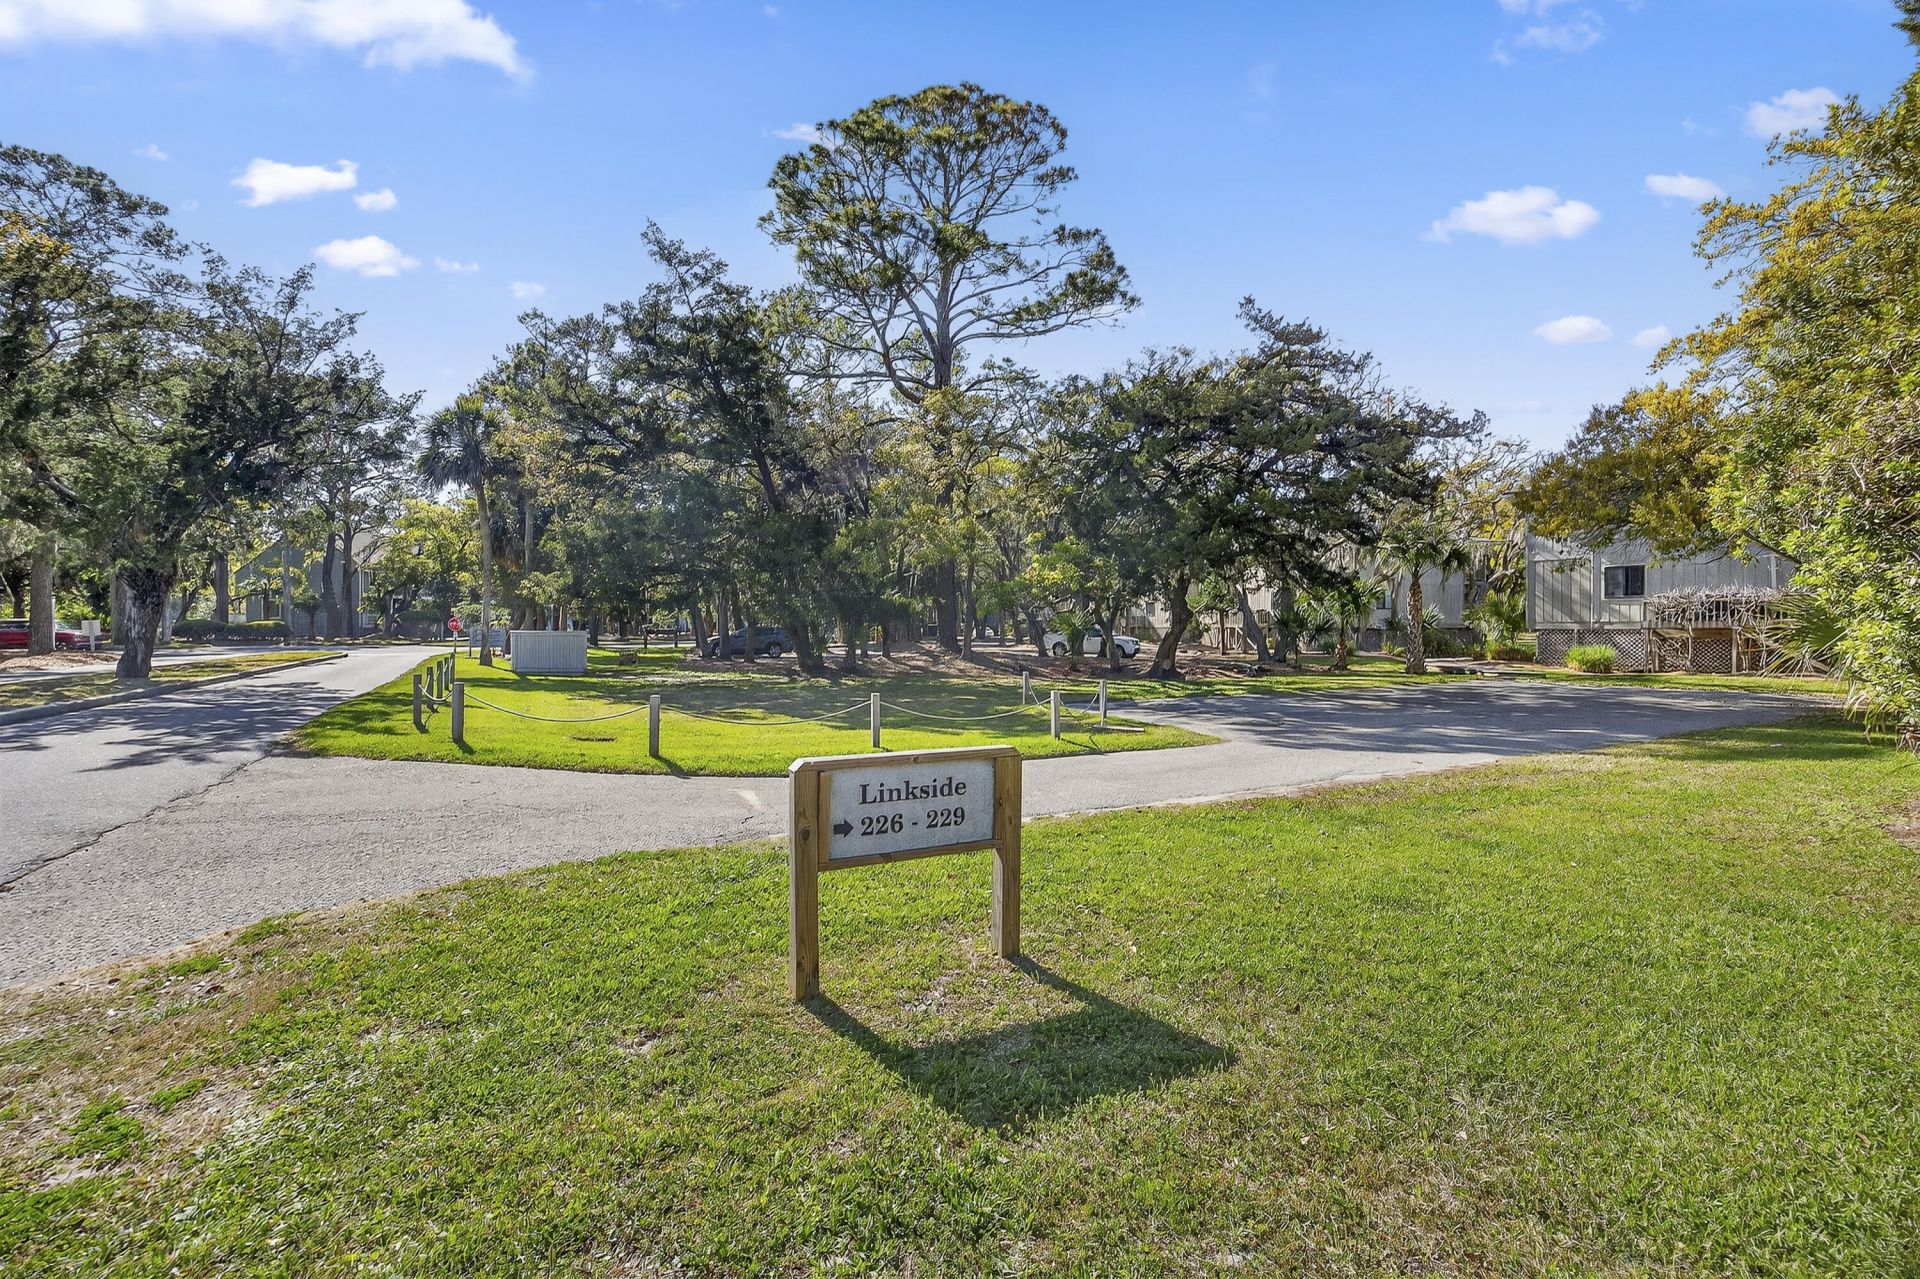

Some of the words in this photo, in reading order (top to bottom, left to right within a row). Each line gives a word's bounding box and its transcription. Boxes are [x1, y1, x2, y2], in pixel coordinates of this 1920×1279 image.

[859, 777, 967, 805] Linkside
[860, 813, 904, 836] 226
[926, 806, 966, 829] 229
